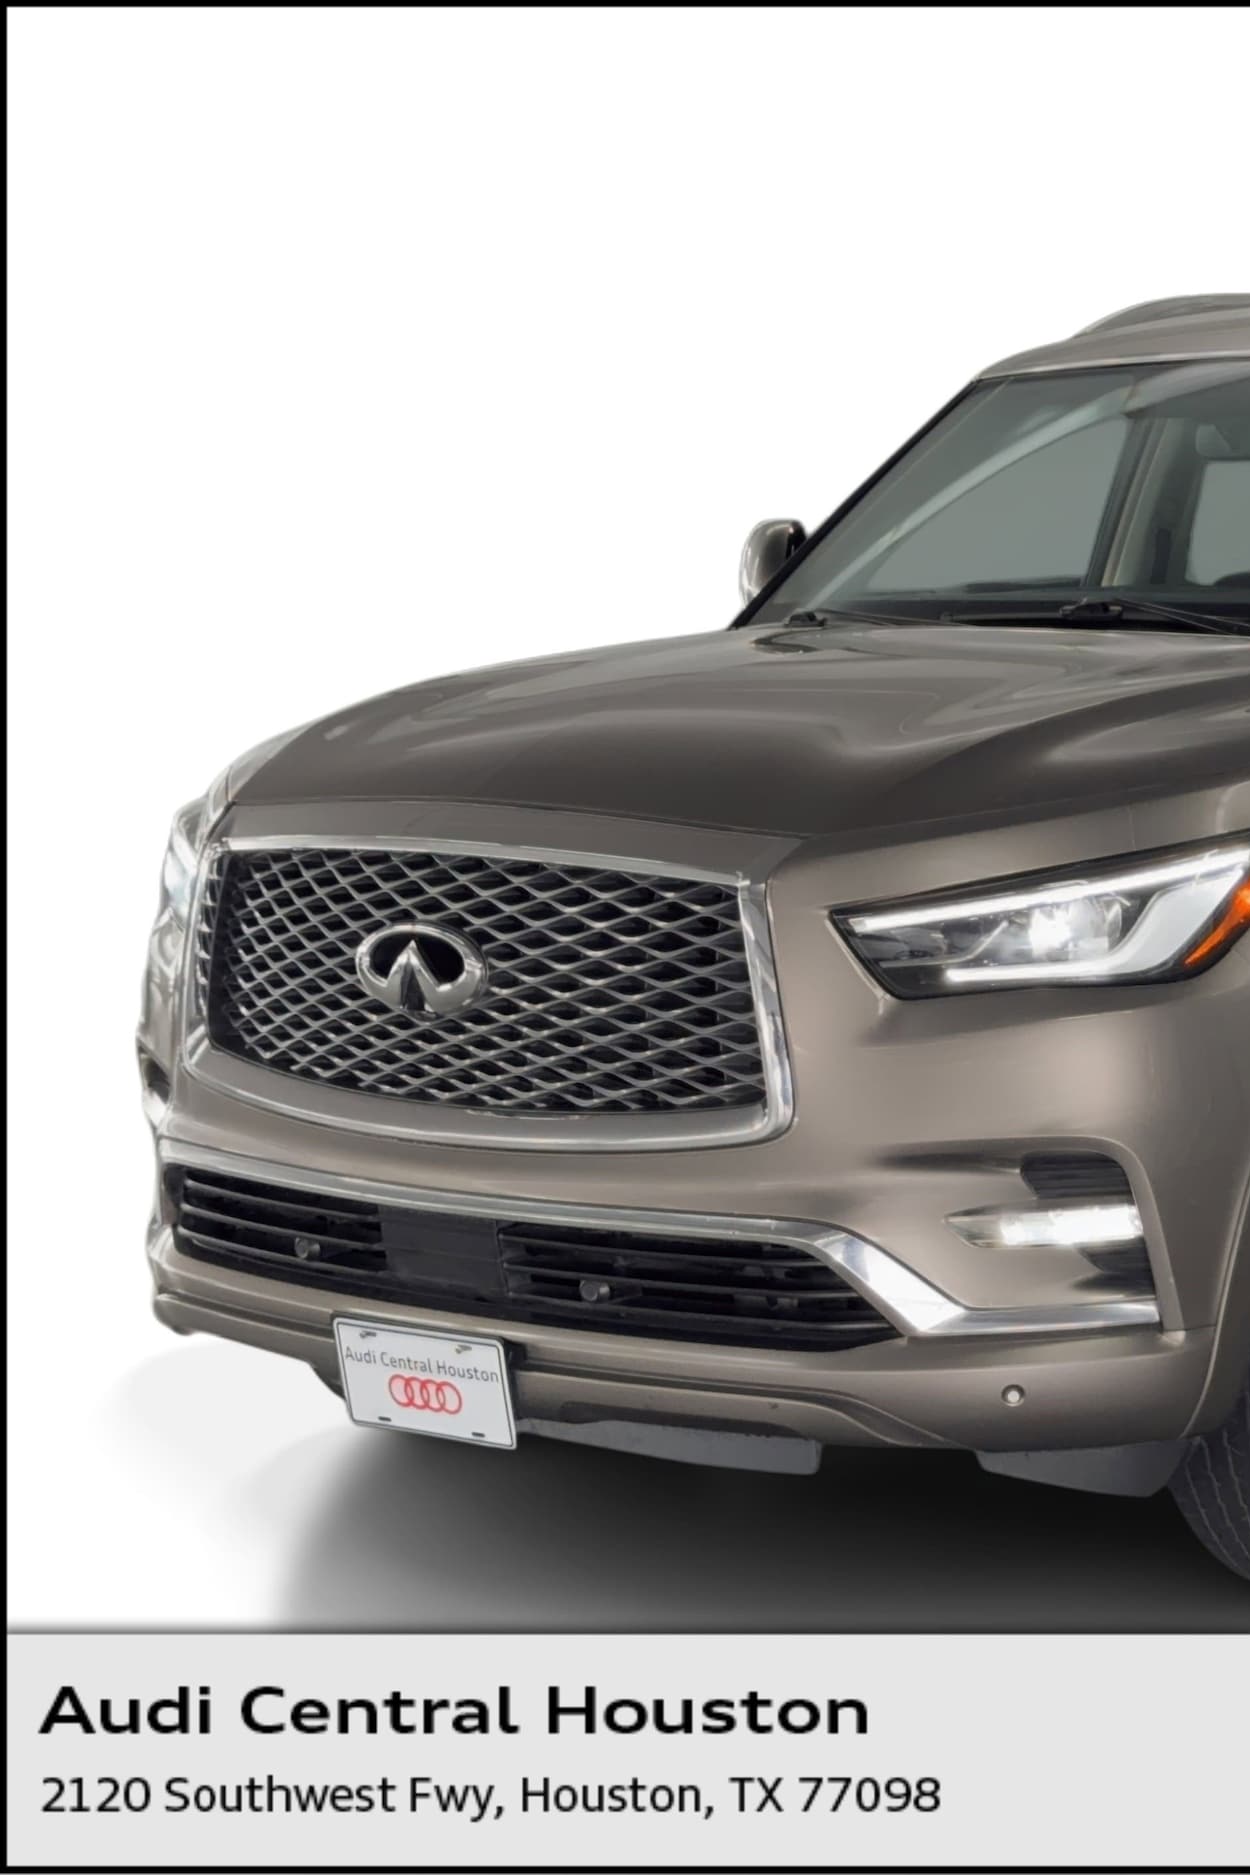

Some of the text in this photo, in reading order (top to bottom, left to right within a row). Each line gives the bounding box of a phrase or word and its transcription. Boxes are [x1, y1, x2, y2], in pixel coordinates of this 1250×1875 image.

[345, 1346, 499, 1383] Audi Central Houston
